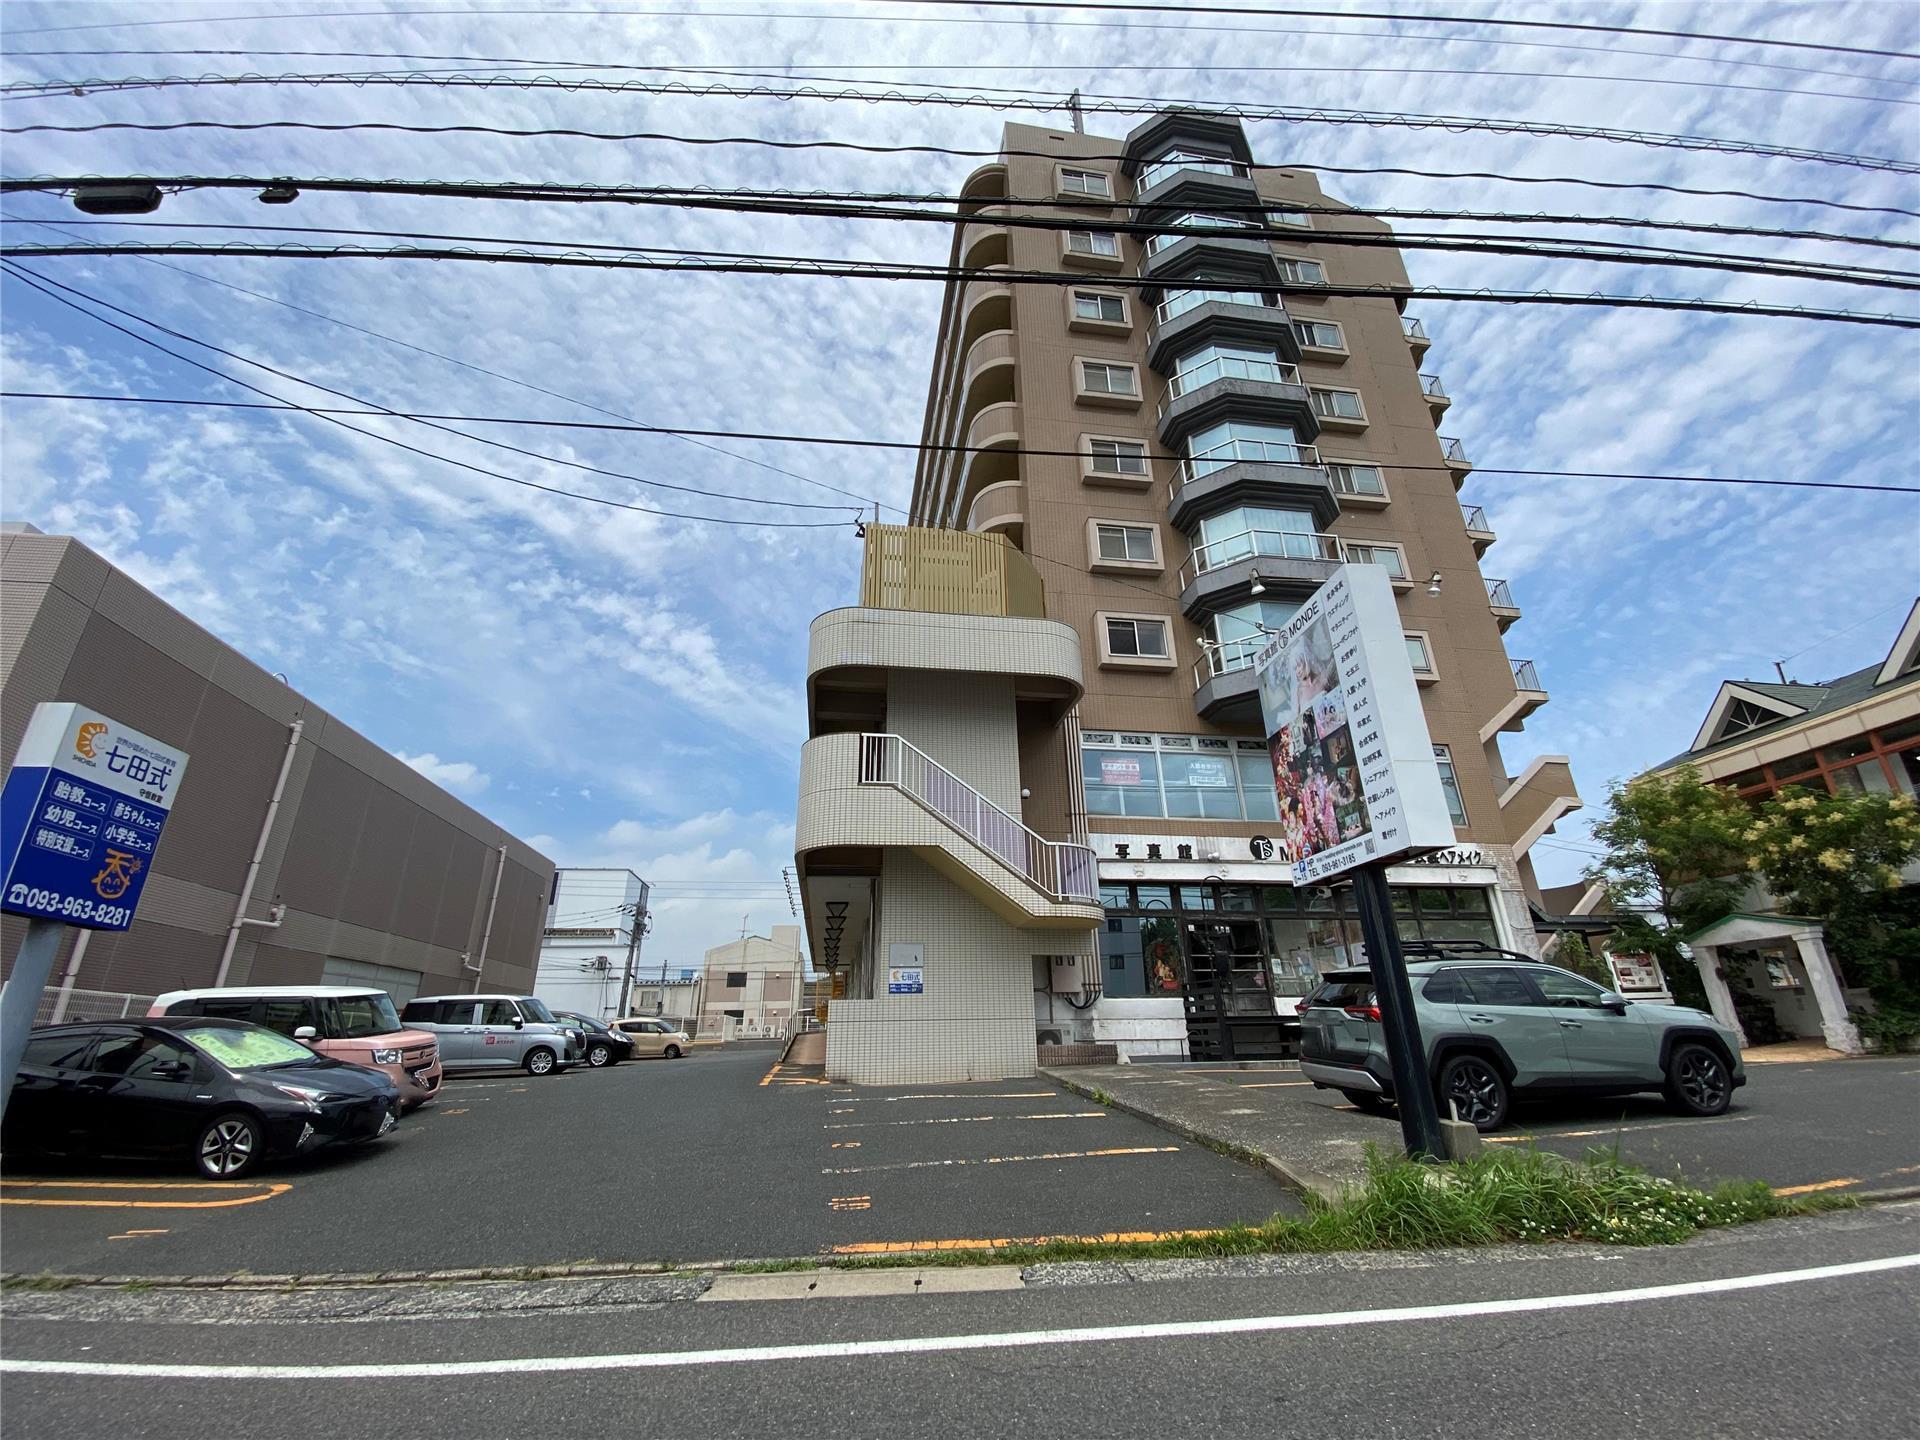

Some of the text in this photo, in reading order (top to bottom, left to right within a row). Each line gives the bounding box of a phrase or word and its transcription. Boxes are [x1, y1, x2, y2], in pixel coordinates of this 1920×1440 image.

[1288, 601, 1320, 638] MONDE
[105, 745, 172, 792] 七田式
[1362, 749, 1383, 767] 証明写真
[1364, 768, 1389, 785] シニアフォト
[54, 780, 107, 812] 胎教コース
[44, 804, 97, 835] 幼児コース
[114, 801, 161, 831] 赤ちゃんコース
[1374, 806, 1396, 821] ヘアメイク
[36, 828, 90, 858] 特別支援コース
[105, 824, 152, 851] 小学生コース
[1309, 867, 1320, 878] TEL
[26, 888, 131, 927] 093-963-8281
